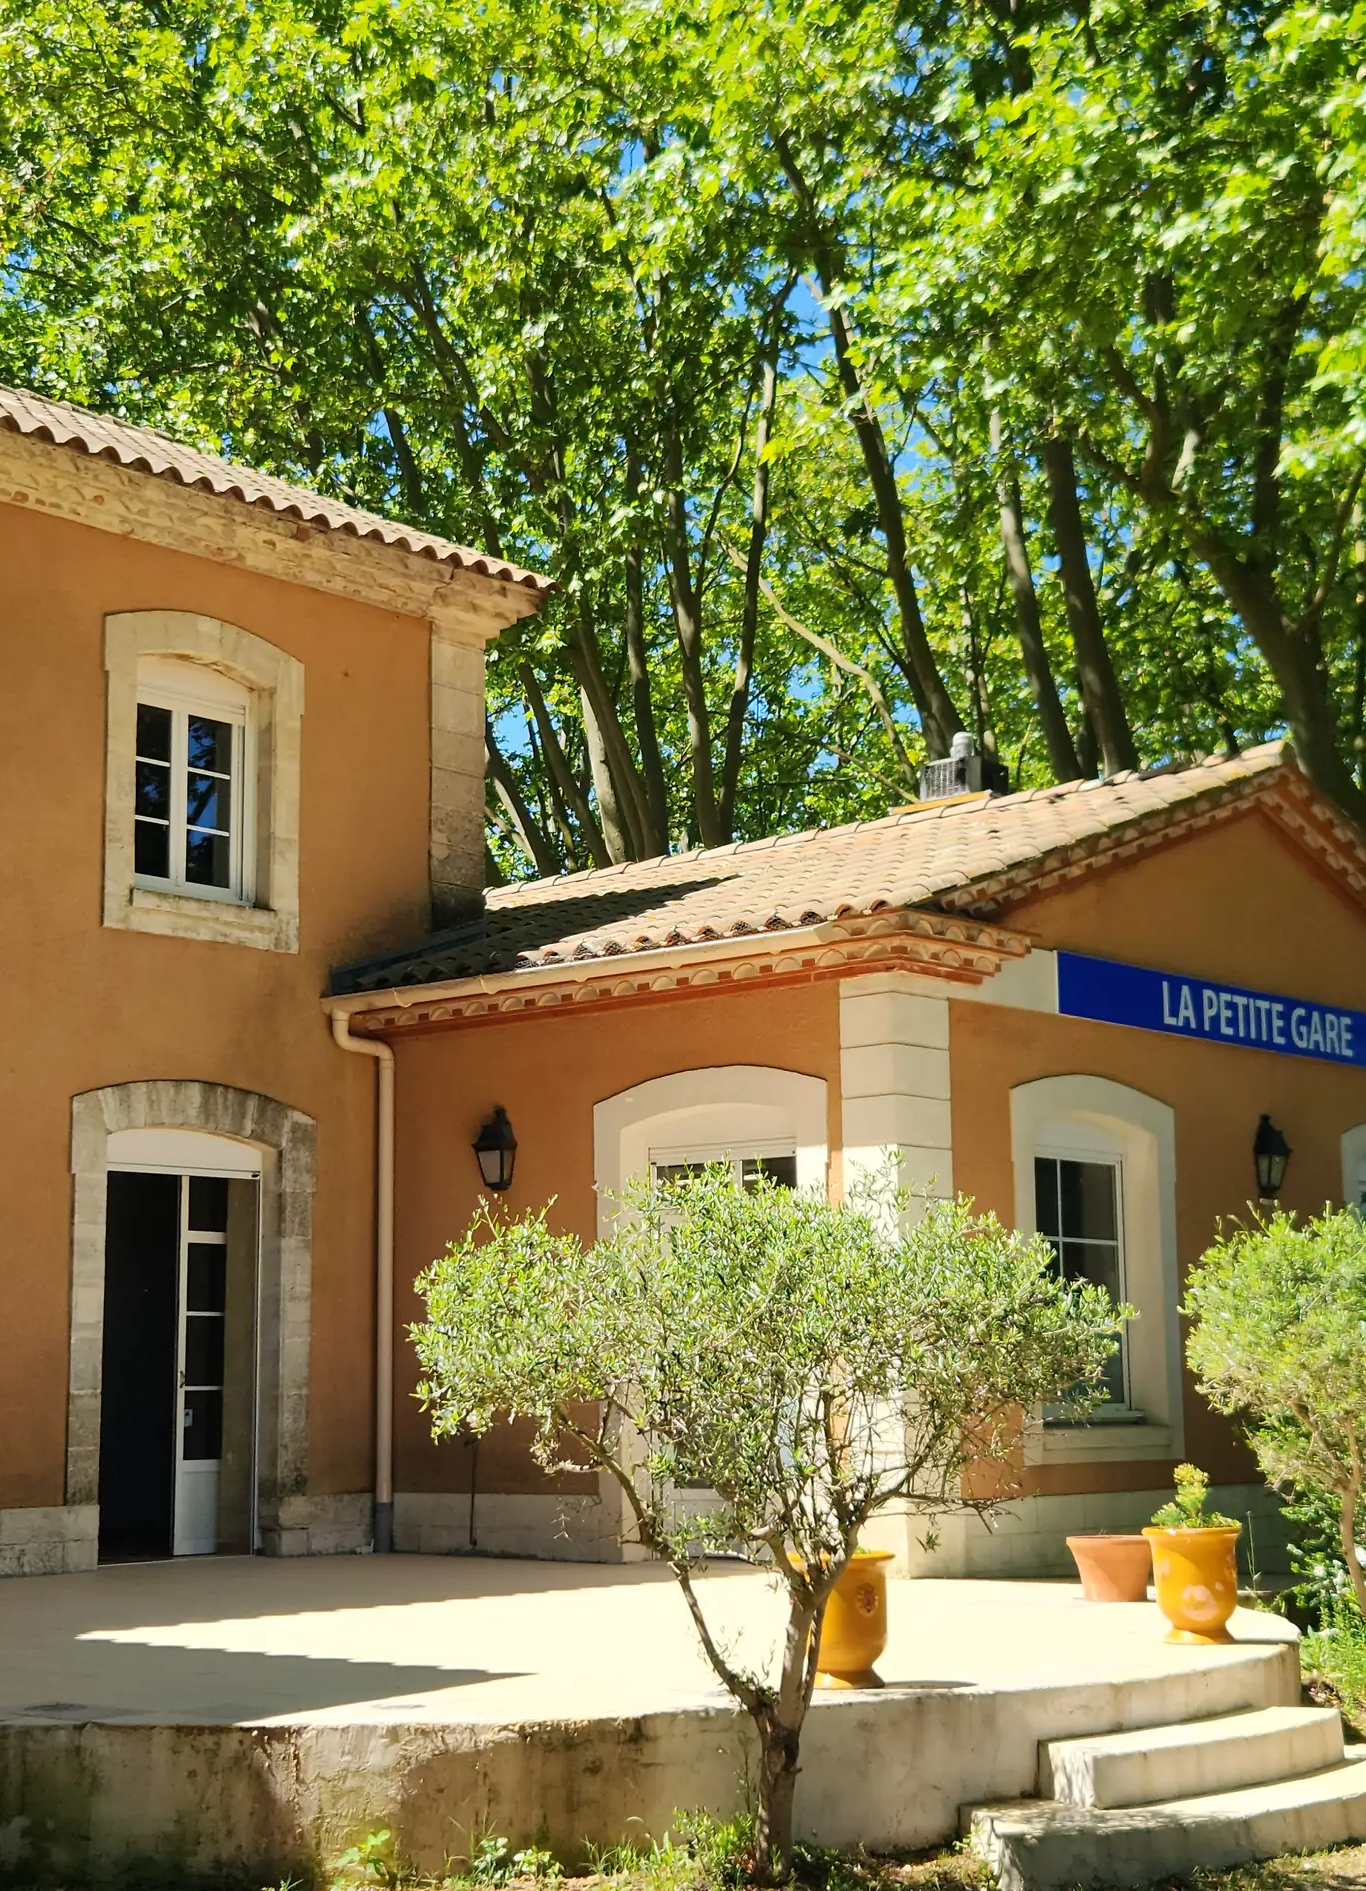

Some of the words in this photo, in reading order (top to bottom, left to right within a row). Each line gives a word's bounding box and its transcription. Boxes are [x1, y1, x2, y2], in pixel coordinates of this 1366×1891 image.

[1162, 980, 1197, 1029] LA
[1202, 988, 1286, 1045] PETITE
[1290, 1007, 1354, 1057] GARE
